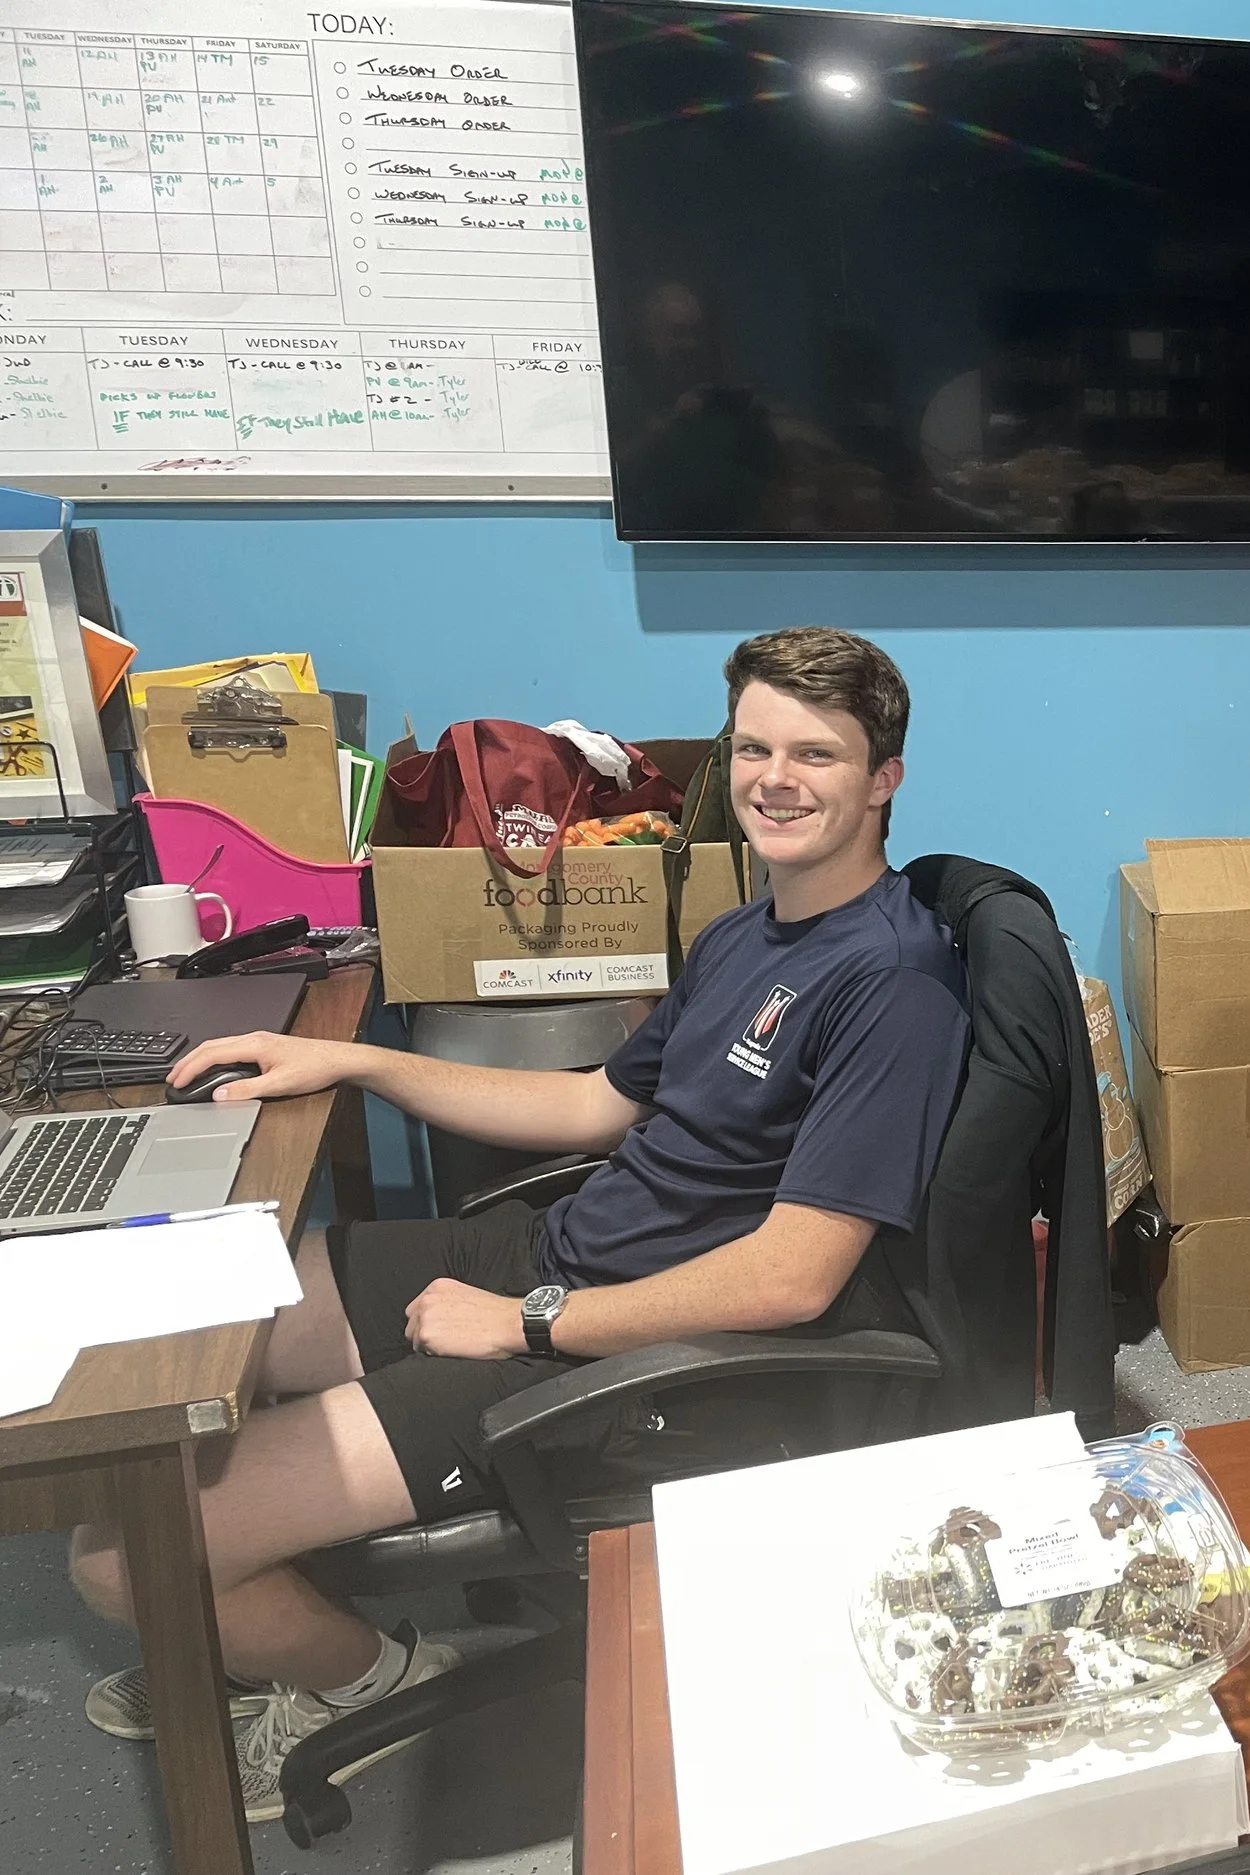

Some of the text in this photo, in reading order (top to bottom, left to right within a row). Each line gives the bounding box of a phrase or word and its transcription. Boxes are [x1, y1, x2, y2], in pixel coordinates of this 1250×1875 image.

[307, 13, 395, 35] TODAY:
[24, 32, 65, 41] TUESDAY
[77, 35, 132, 44] WEDNESDAY
[141, 37, 187, 45] THURSDAY
[140, 52, 155, 61] 13
[253, 56, 270, 66] 15
[144, 94, 160, 103] 20
[258, 97, 275, 106] 22
[150, 134, 164, 144] 27
[263, 138, 278, 149] 29
[99, 176, 108, 184] 2
[153, 175, 162, 184] 3
[267, 177, 276, 187] 5
[119, 335, 188, 346] TUESDAY
[246, 338, 338, 349] WEDNESDAY
[389, 339, 466, 350] THURSDAY
[532, 342, 582, 353] FRIDAY
[124, 360, 153, 369] CALL
[158, 357, 170, 368] @
[175, 358, 204, 368] 9:30
[261, 361, 291, 369] CALL
[296, 361, 306, 369] @
[310, 360, 342, 371] 9:30
[555, 360, 569, 373] @
[438, 375, 466, 390] Tyler
[568, 873, 623, 887] County
[483, 877, 648, 907] foodbank
[499, 921, 639, 936] Packaging Proudly
[519, 937, 622, 950] Sponsored By
[606, 964, 654, 973] COMCAST
[548, 969, 592, 983] xfinity
[608, 972, 655, 981] BUSINESS
[483, 980, 533, 989] COMCAST
